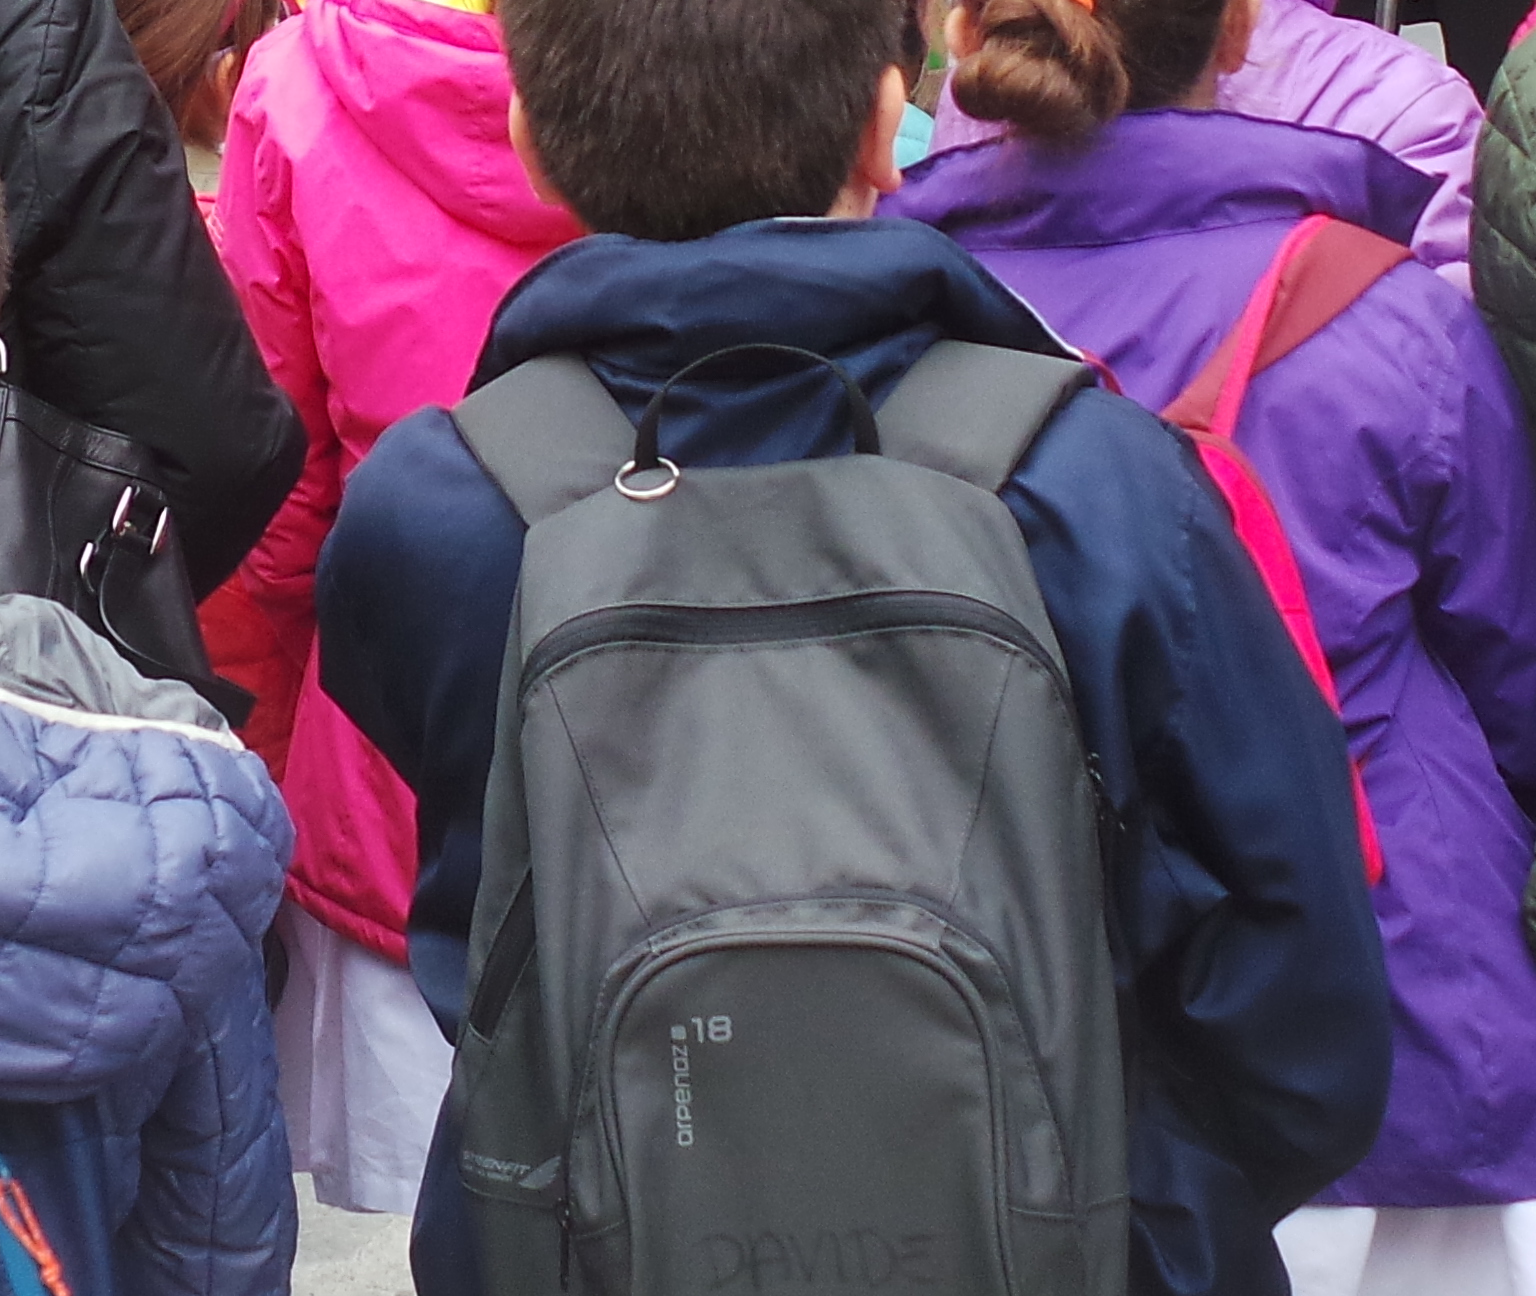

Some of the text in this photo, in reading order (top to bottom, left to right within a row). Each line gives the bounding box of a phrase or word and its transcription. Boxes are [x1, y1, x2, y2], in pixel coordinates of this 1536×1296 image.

[691, 1014, 733, 1044] 18
[670, 1044, 694, 1147] arpenaz
[692, 1227, 936, 1291] DAVIDE
